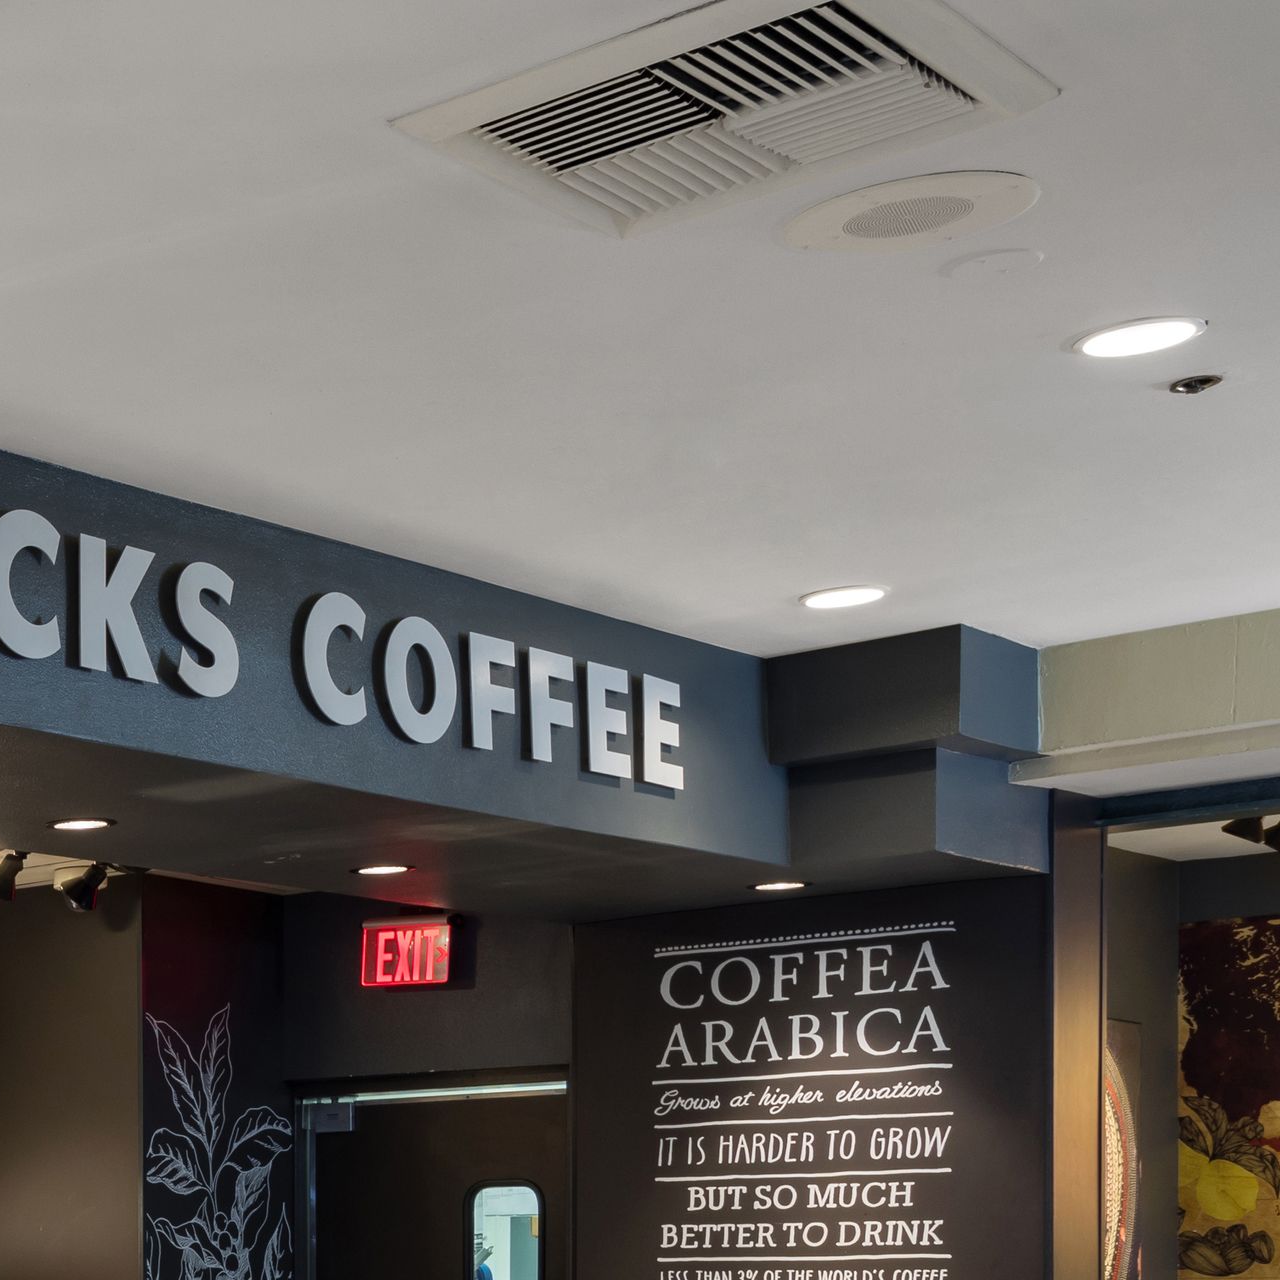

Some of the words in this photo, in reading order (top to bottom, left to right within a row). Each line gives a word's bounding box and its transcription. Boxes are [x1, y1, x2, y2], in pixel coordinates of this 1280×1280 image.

[303, 591, 684, 790] COFFEE
[376, 928, 438, 984] EXIT
[659, 940, 950, 1009] COFFEA
[656, 1006, 951, 1068] ARABICA
[654, 1089, 721, 1116] Grows
[730, 1091, 755, 1109] at
[758, 1085, 824, 1113] higher
[836, 1080, 942, 1103] elevations
[657, 1137, 678, 1167] IT
[687, 1137, 706, 1166] IS
[719, 1130, 815, 1166] HARDER
[826, 1128, 855, 1162] TO
[870, 1125, 952, 1160] GROW
[687, 1186, 747, 1212] BUT
[754, 1184, 797, 1210] SO
[806, 1181, 915, 1209] MUCH
[661, 1223, 776, 1249] BETTER
[786, 1222, 828, 1248] TO
[836, 1220, 943, 1247] DRINK
